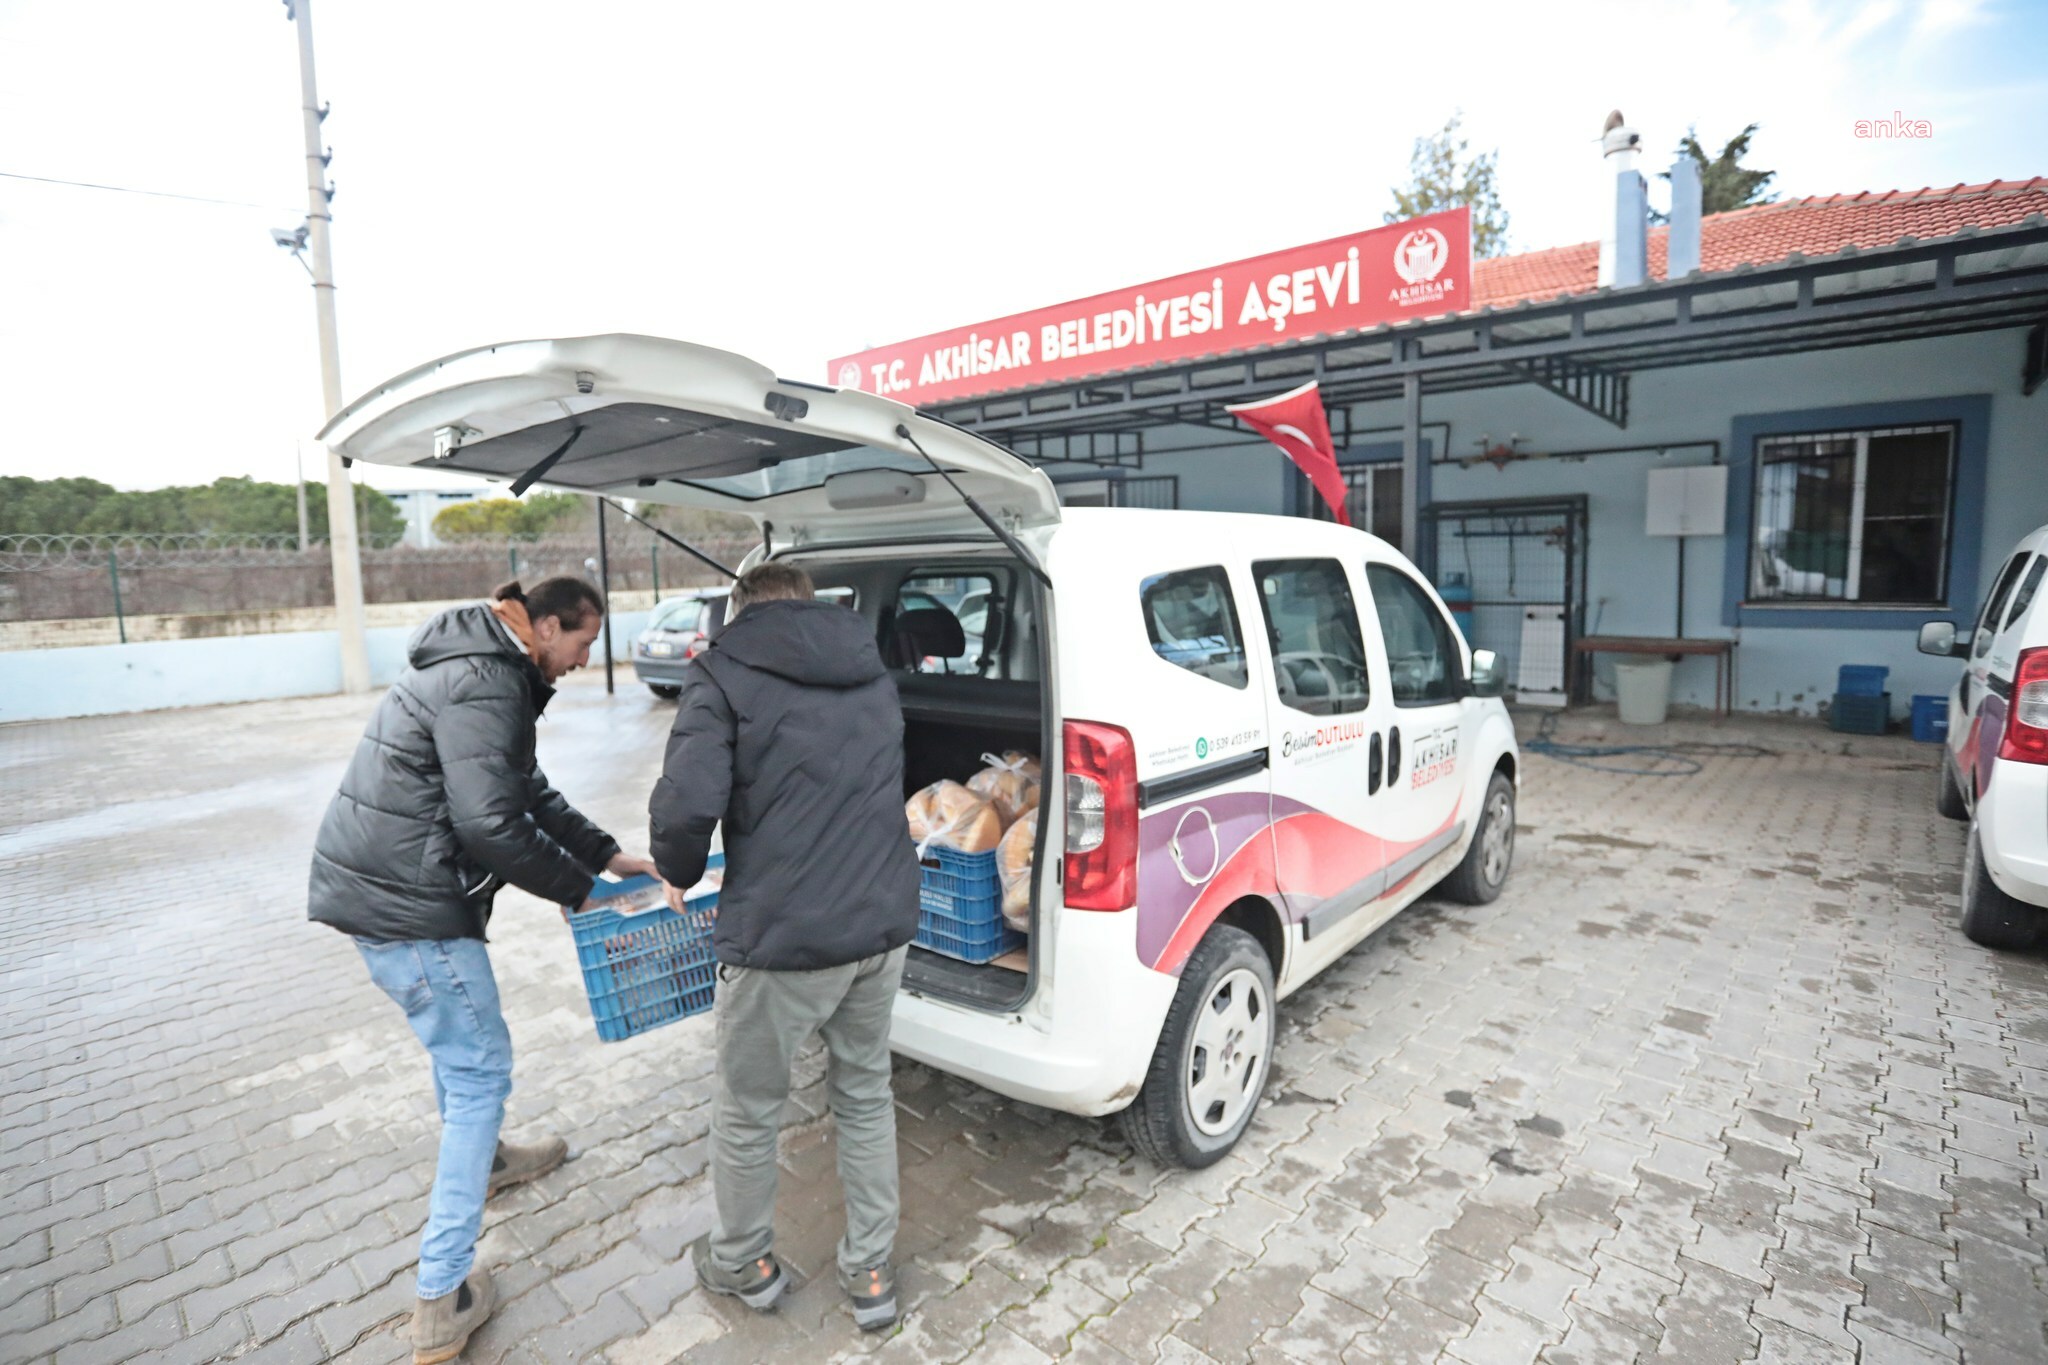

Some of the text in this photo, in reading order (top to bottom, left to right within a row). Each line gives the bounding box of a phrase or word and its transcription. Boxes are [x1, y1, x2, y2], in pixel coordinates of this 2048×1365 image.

[871, 246, 1360, 395] T.C. AKHİSAR BELEDİYESİ AŞEVİ
